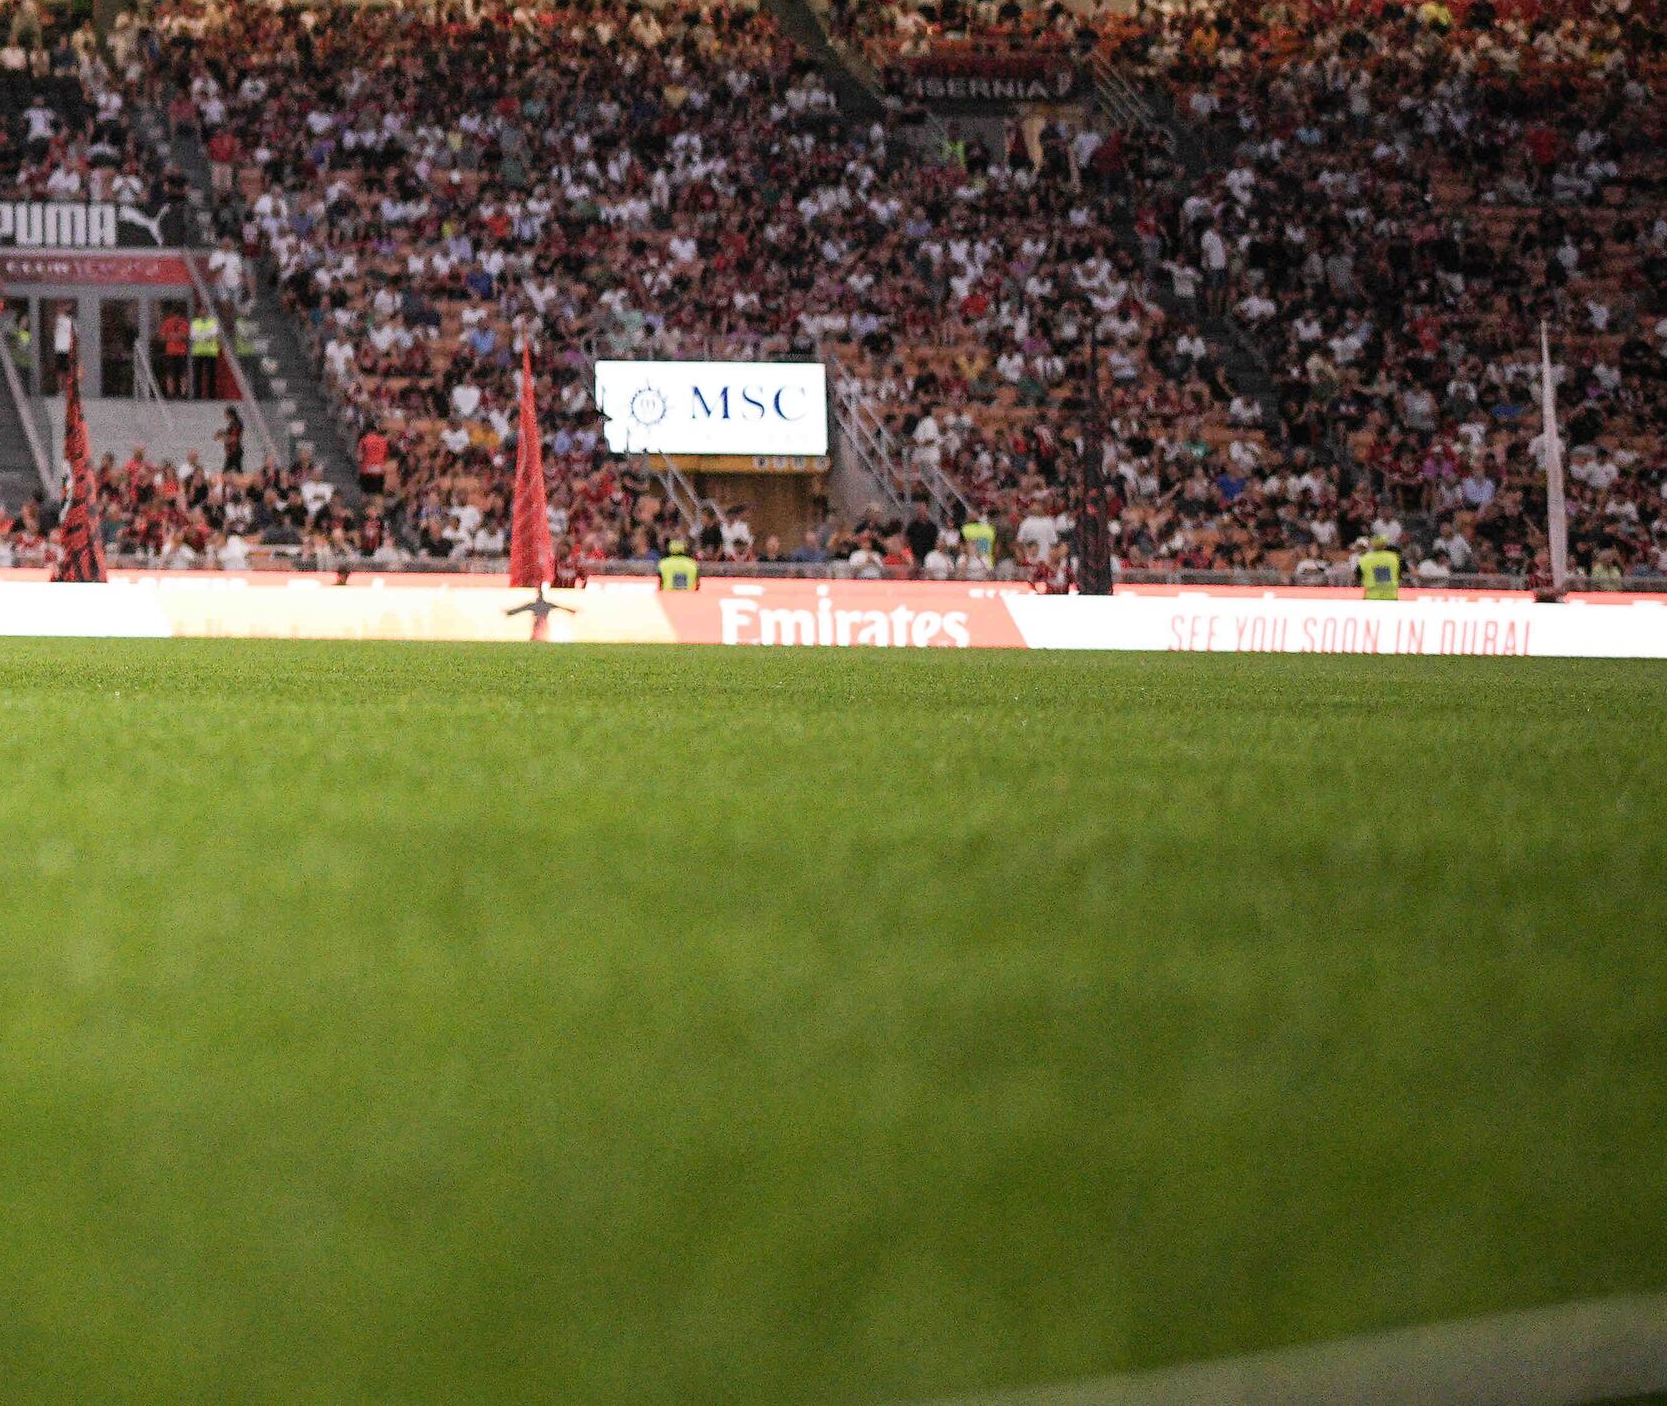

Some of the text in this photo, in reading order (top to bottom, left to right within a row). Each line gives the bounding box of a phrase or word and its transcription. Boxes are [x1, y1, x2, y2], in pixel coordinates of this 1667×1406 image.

[691, 384, 808, 422] MSC
[719, 597, 970, 646] Emirates
[1169, 614, 1535, 655] SEE YOU SOON IN DUBAI
